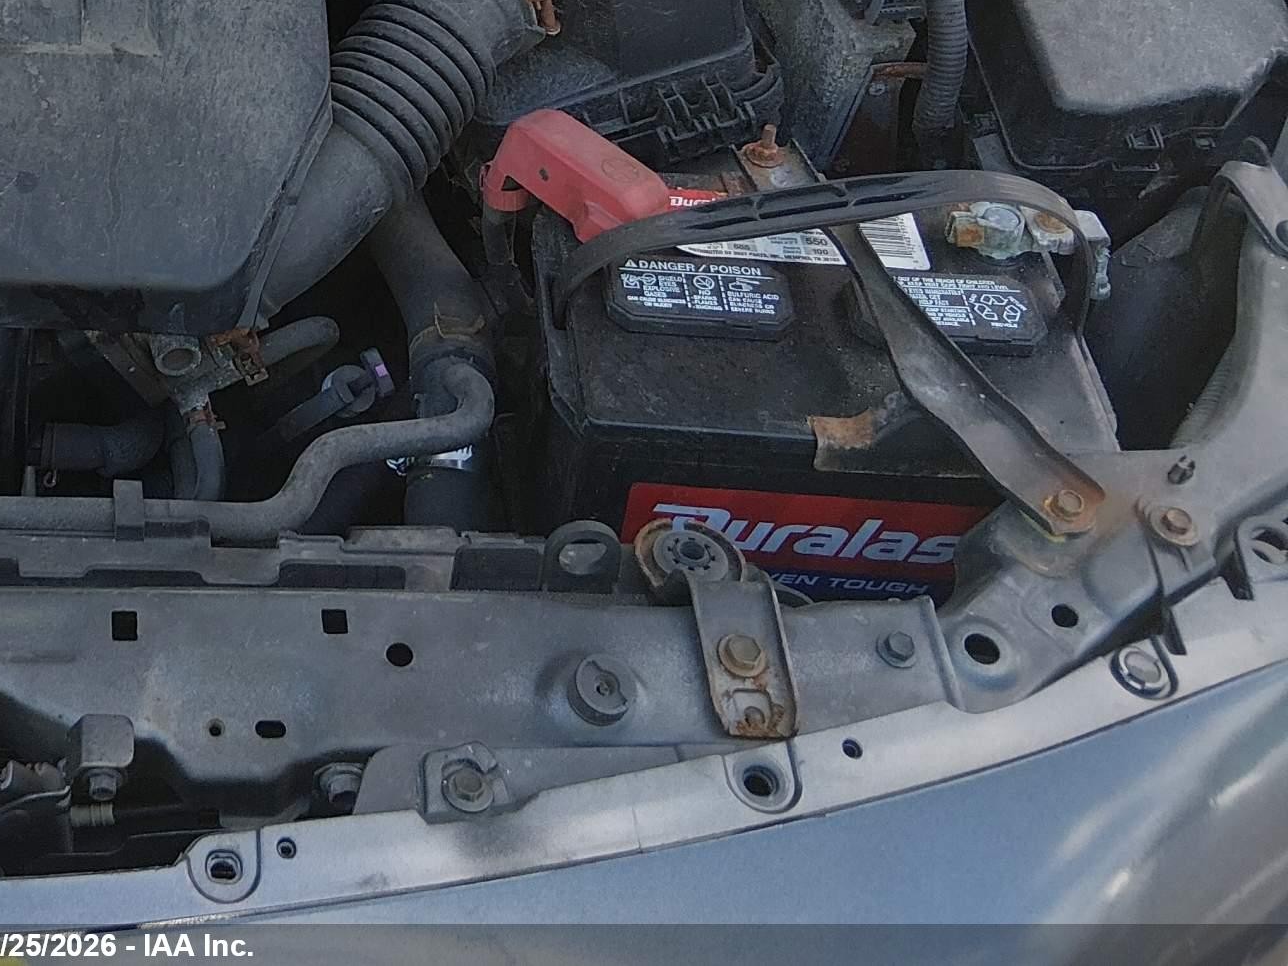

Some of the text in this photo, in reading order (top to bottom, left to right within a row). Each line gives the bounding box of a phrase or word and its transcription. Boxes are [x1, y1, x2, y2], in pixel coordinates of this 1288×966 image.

[638, 260, 762, 276] DANGER / POISON
[643, 285, 680, 293] EXPLOSIVE
[727, 291, 761, 299] SULFURIC
[829, 577, 929, 594] TOUGH
